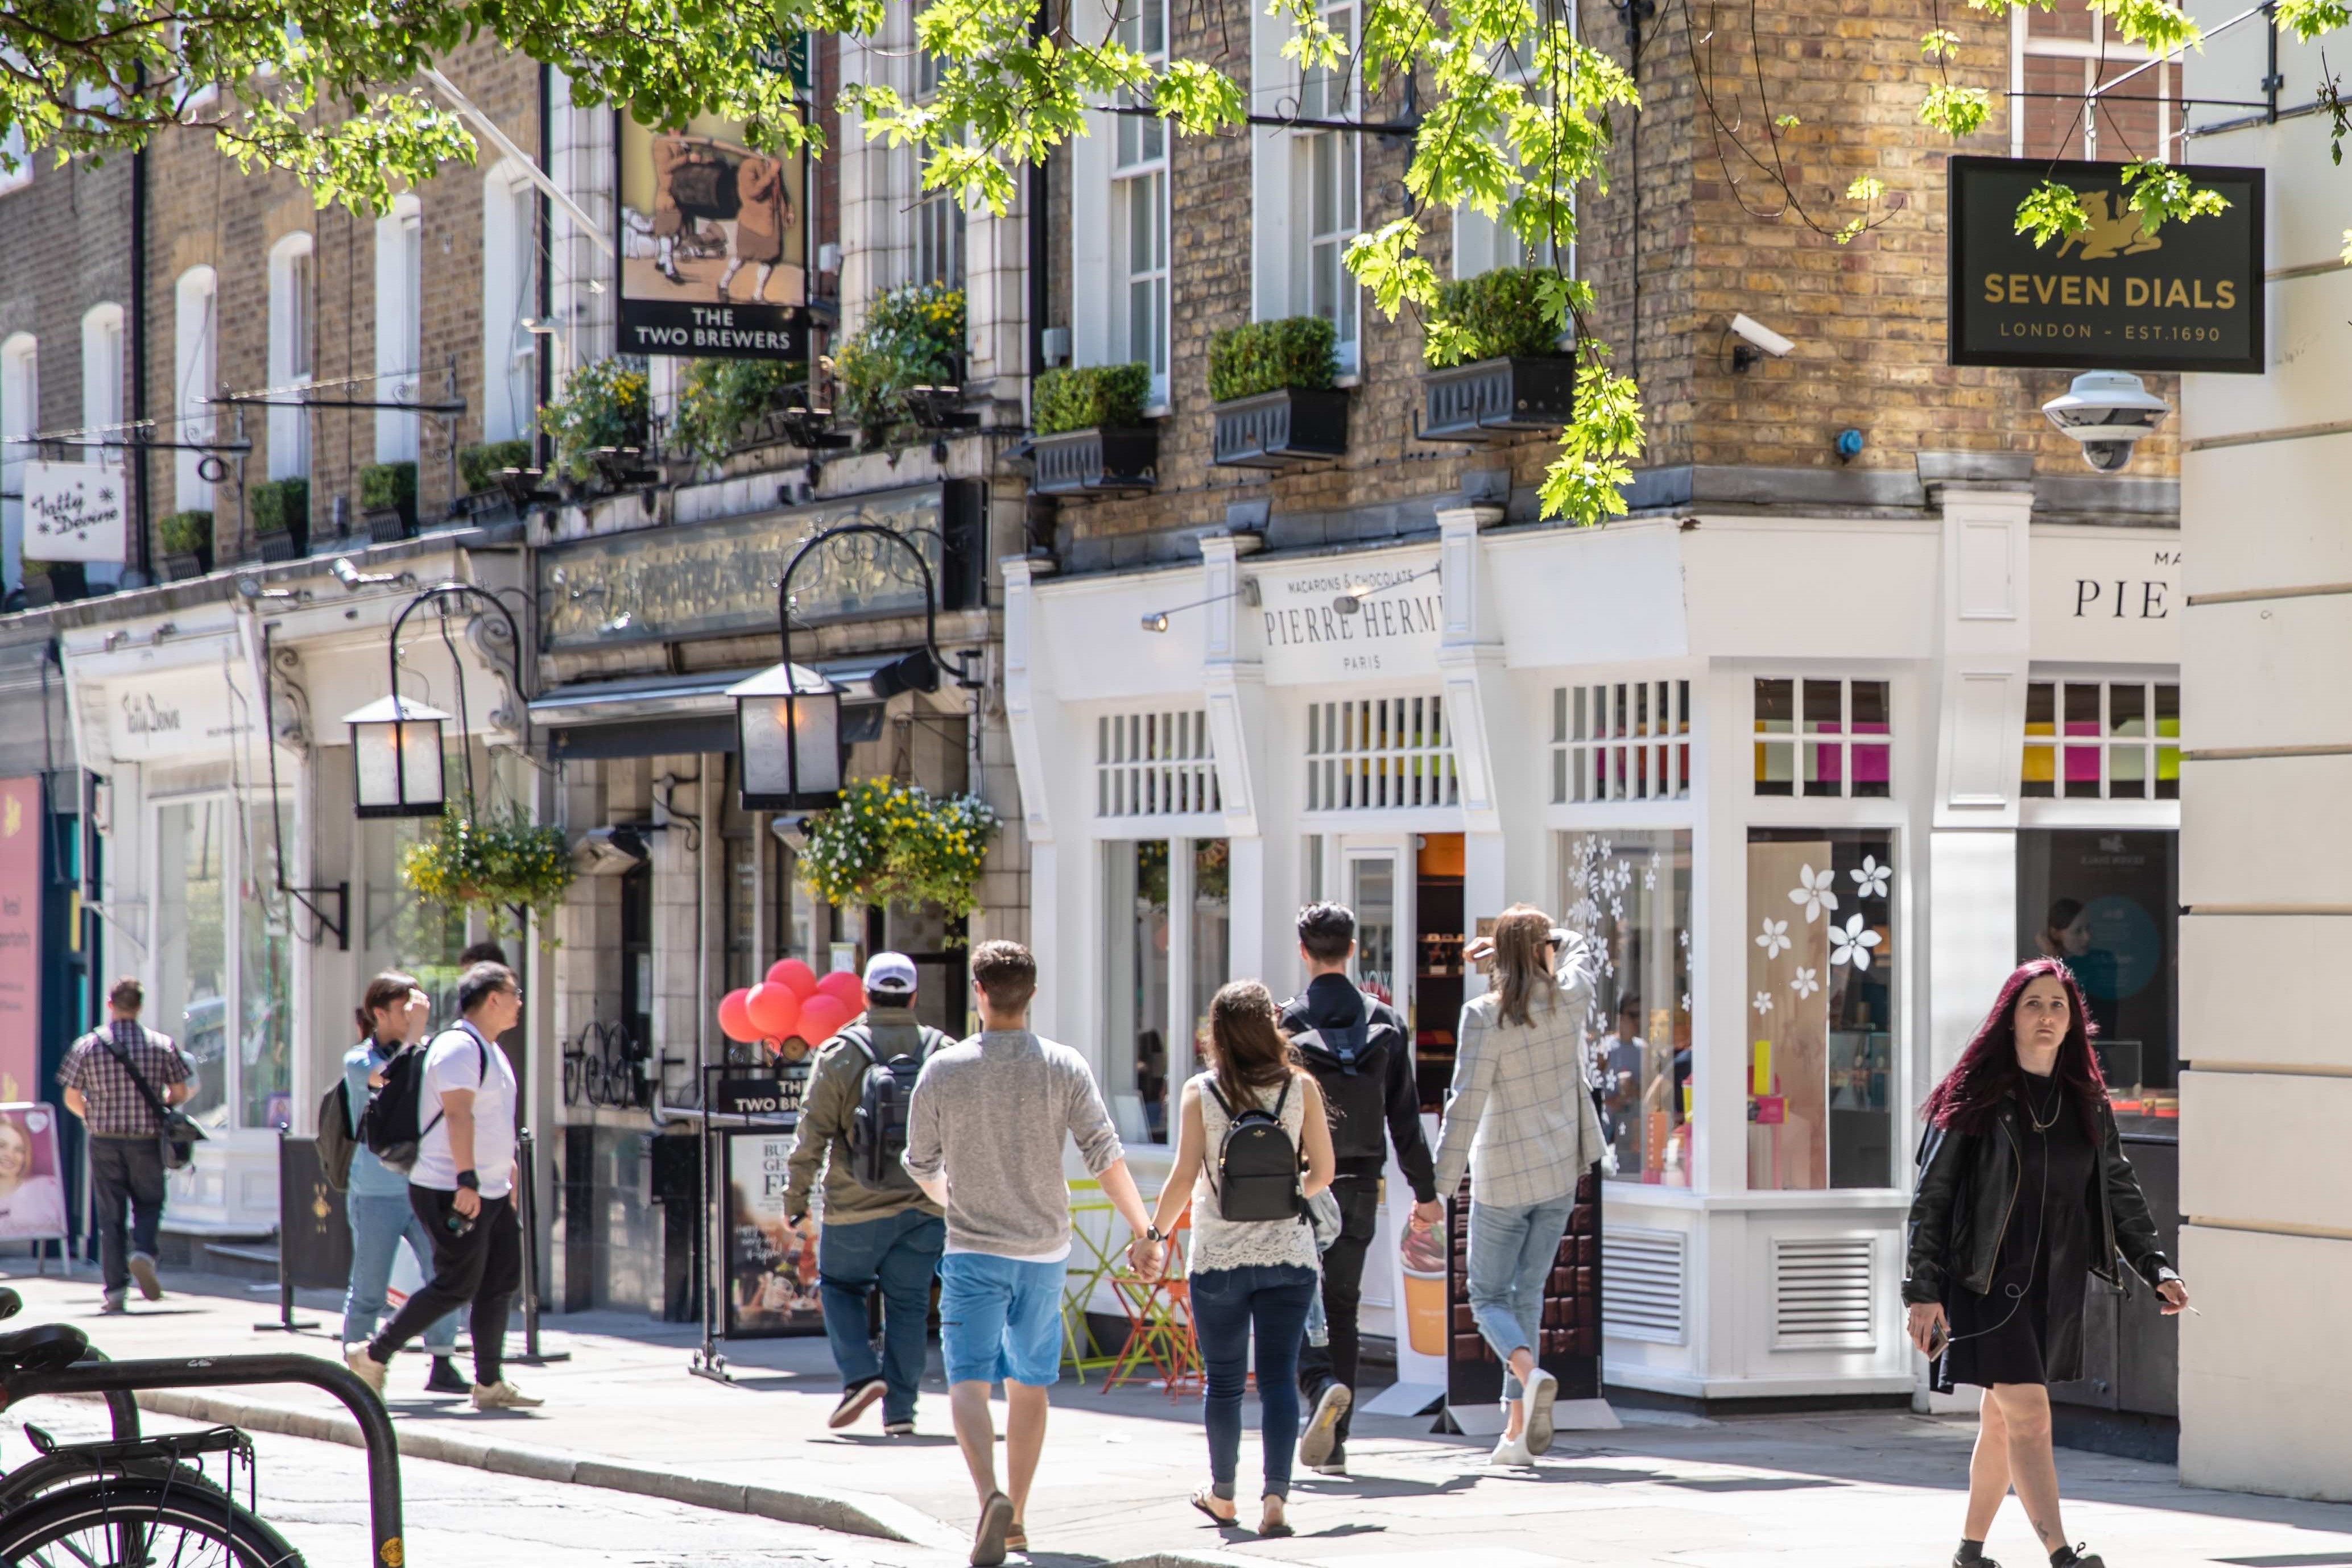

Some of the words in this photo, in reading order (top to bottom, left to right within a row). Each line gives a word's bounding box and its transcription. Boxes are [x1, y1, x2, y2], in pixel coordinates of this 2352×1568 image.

[1984, 273, 2109, 306] SEVEN
[2126, 278, 2236, 309] DIALS
[691, 308, 734, 327] THE
[634, 326, 688, 345] TWO
[693, 328, 790, 349] BREWERS
[2000, 322, 2091, 338] LONDON
[2125, 325, 2219, 341] EST.1690
[1288, 576, 1341, 594] MACARONS
[1355, 569, 1414, 588] CHOCOLATS
[1264, 605, 1354, 646] PIERRE
[1362, 595, 1442, 638] HERM
[1344, 655, 1381, 670] PARIS
[734, 1097, 776, 1112] TWO
[764, 1159, 787, 1171] GE
